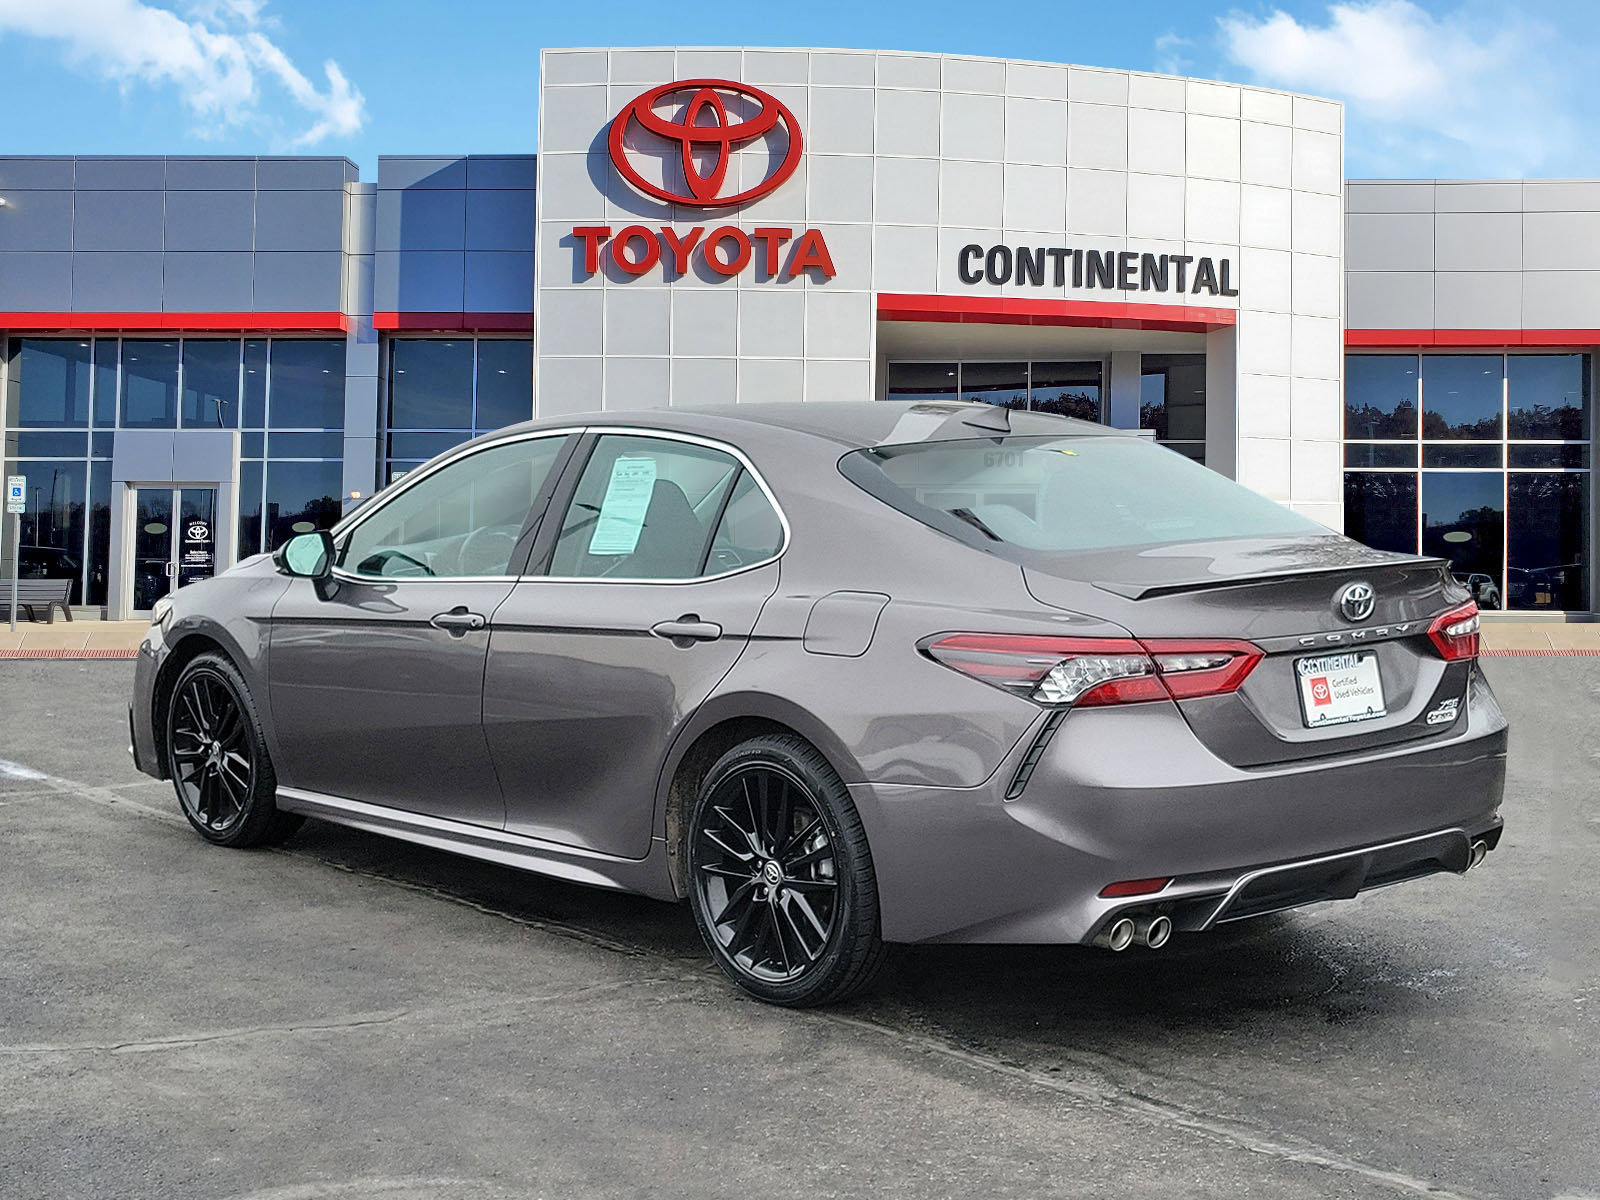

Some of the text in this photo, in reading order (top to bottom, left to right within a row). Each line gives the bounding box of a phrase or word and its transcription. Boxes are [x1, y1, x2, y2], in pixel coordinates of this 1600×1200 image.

[573, 225, 837, 277] TOYOTA
[958, 244, 1239, 297] CONTINENTAL
[983, 451, 1024, 467] 6701
[1300, 654, 1360, 674] CONTINENTAL
[1332, 676, 1357, 688] Certified
[1334, 686, 1374, 699] Used Vehicles
